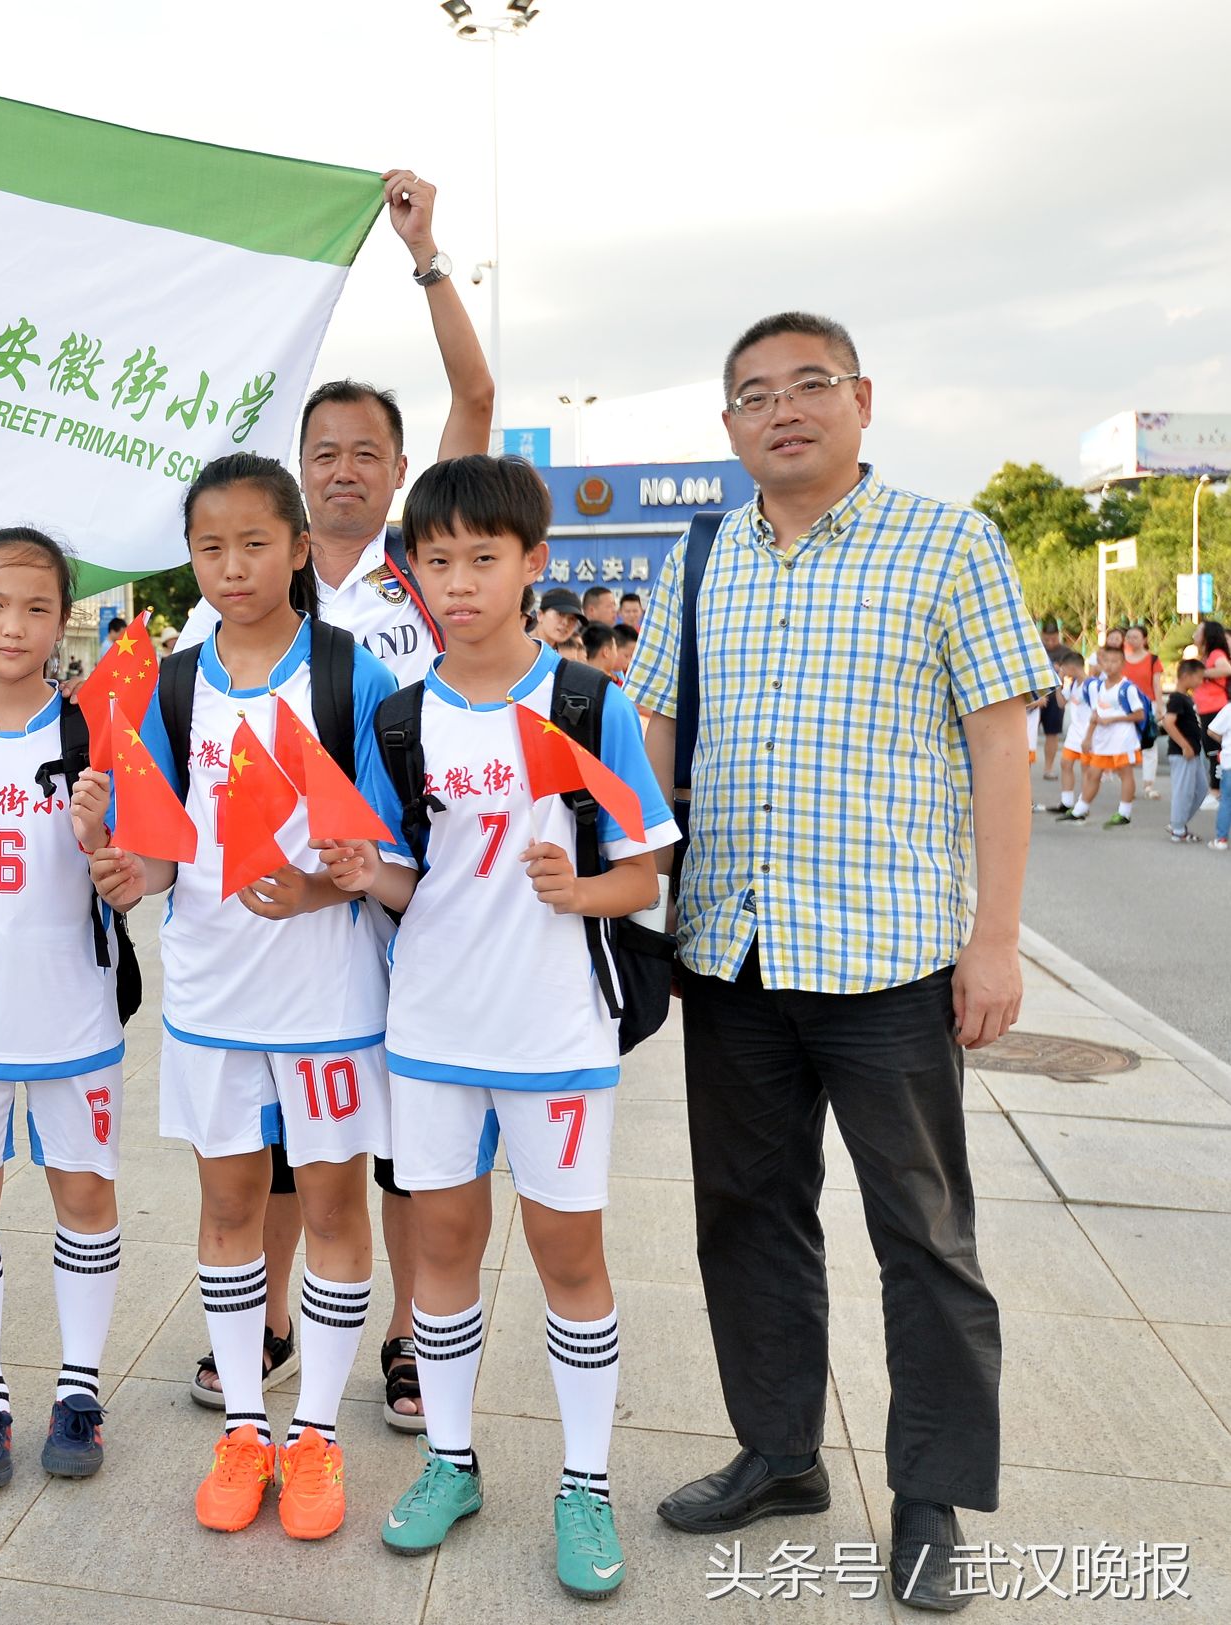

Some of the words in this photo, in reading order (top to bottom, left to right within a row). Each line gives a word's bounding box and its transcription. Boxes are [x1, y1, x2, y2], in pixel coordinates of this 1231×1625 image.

[54, 417, 165, 471] PRIMARY
[639, 476, 723, 506] NO.004
[536, 556, 650, 583] 场公安局
[188, 740, 229, 770] 徽
[423, 759, 524, 799] 徽街
[474, 811, 510, 878] 7
[85, 1086, 112, 1145] 6
[295, 1056, 361, 1122] 10
[546, 1094, 587, 1168] 7
